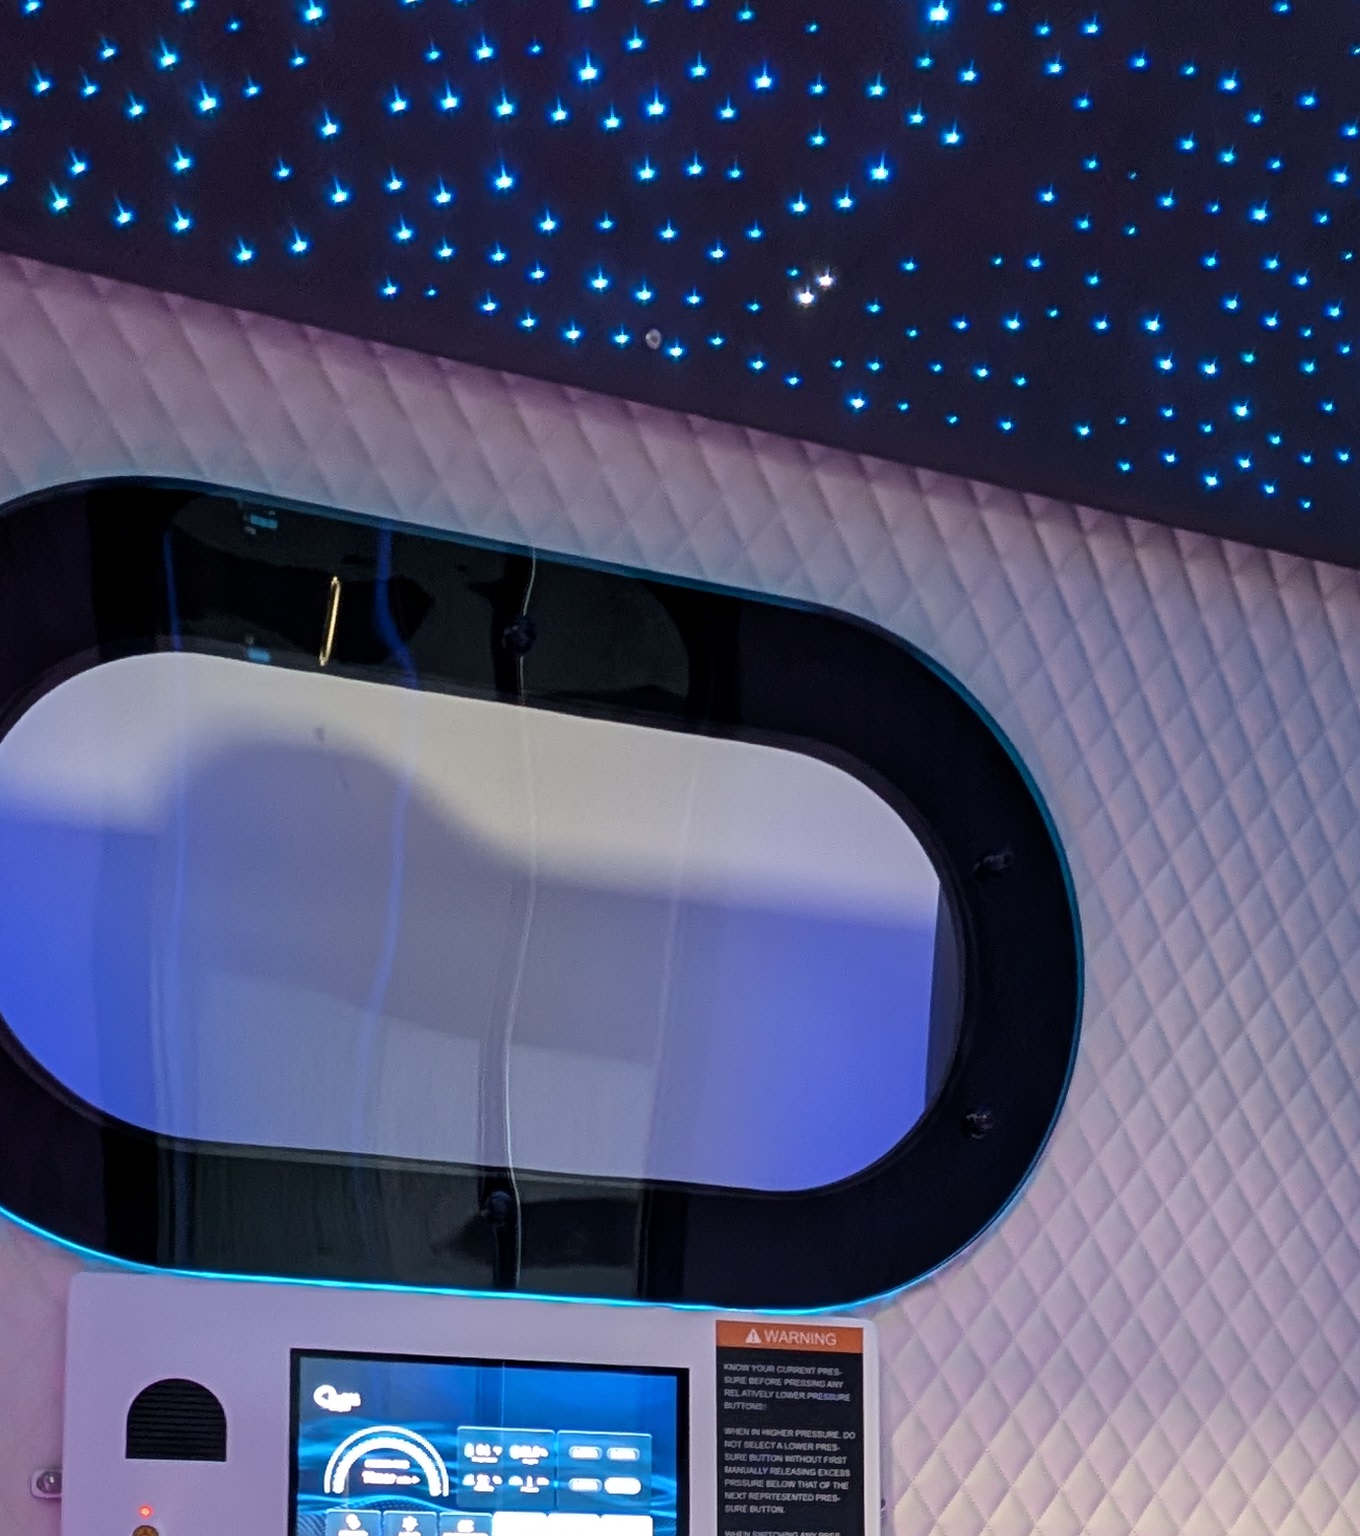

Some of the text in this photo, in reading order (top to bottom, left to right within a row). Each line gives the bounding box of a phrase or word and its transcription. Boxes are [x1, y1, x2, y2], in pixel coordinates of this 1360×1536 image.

[764, 1329, 837, 1346] WARNING
[752, 1365, 775, 1373] YOUR
[777, 1366, 816, 1375] CURRENT
[817, 1367, 842, 1376] PRES-
[724, 1377, 843, 1388] SURE BEFORE PRESSING ANY
[724, 1389, 850, 1401] RELATIVELY LOWER PRESSURE
[724, 1428, 750, 1436] WHEN
[751, 1428, 760, 1436] IN
[762, 1429, 793, 1437] HIGHER
[843, 1431, 856, 1439] DO
[824, 1456, 847, 1464] FIRST
[725, 1466, 851, 1477] MANUALLY RELEASING EXCESS
[766, 1480, 796, 1488] BELOW
[725, 1492, 747, 1500] NEXT
[815, 1494, 841, 1502] PRES-
[725, 1505, 748, 1513] SURE
